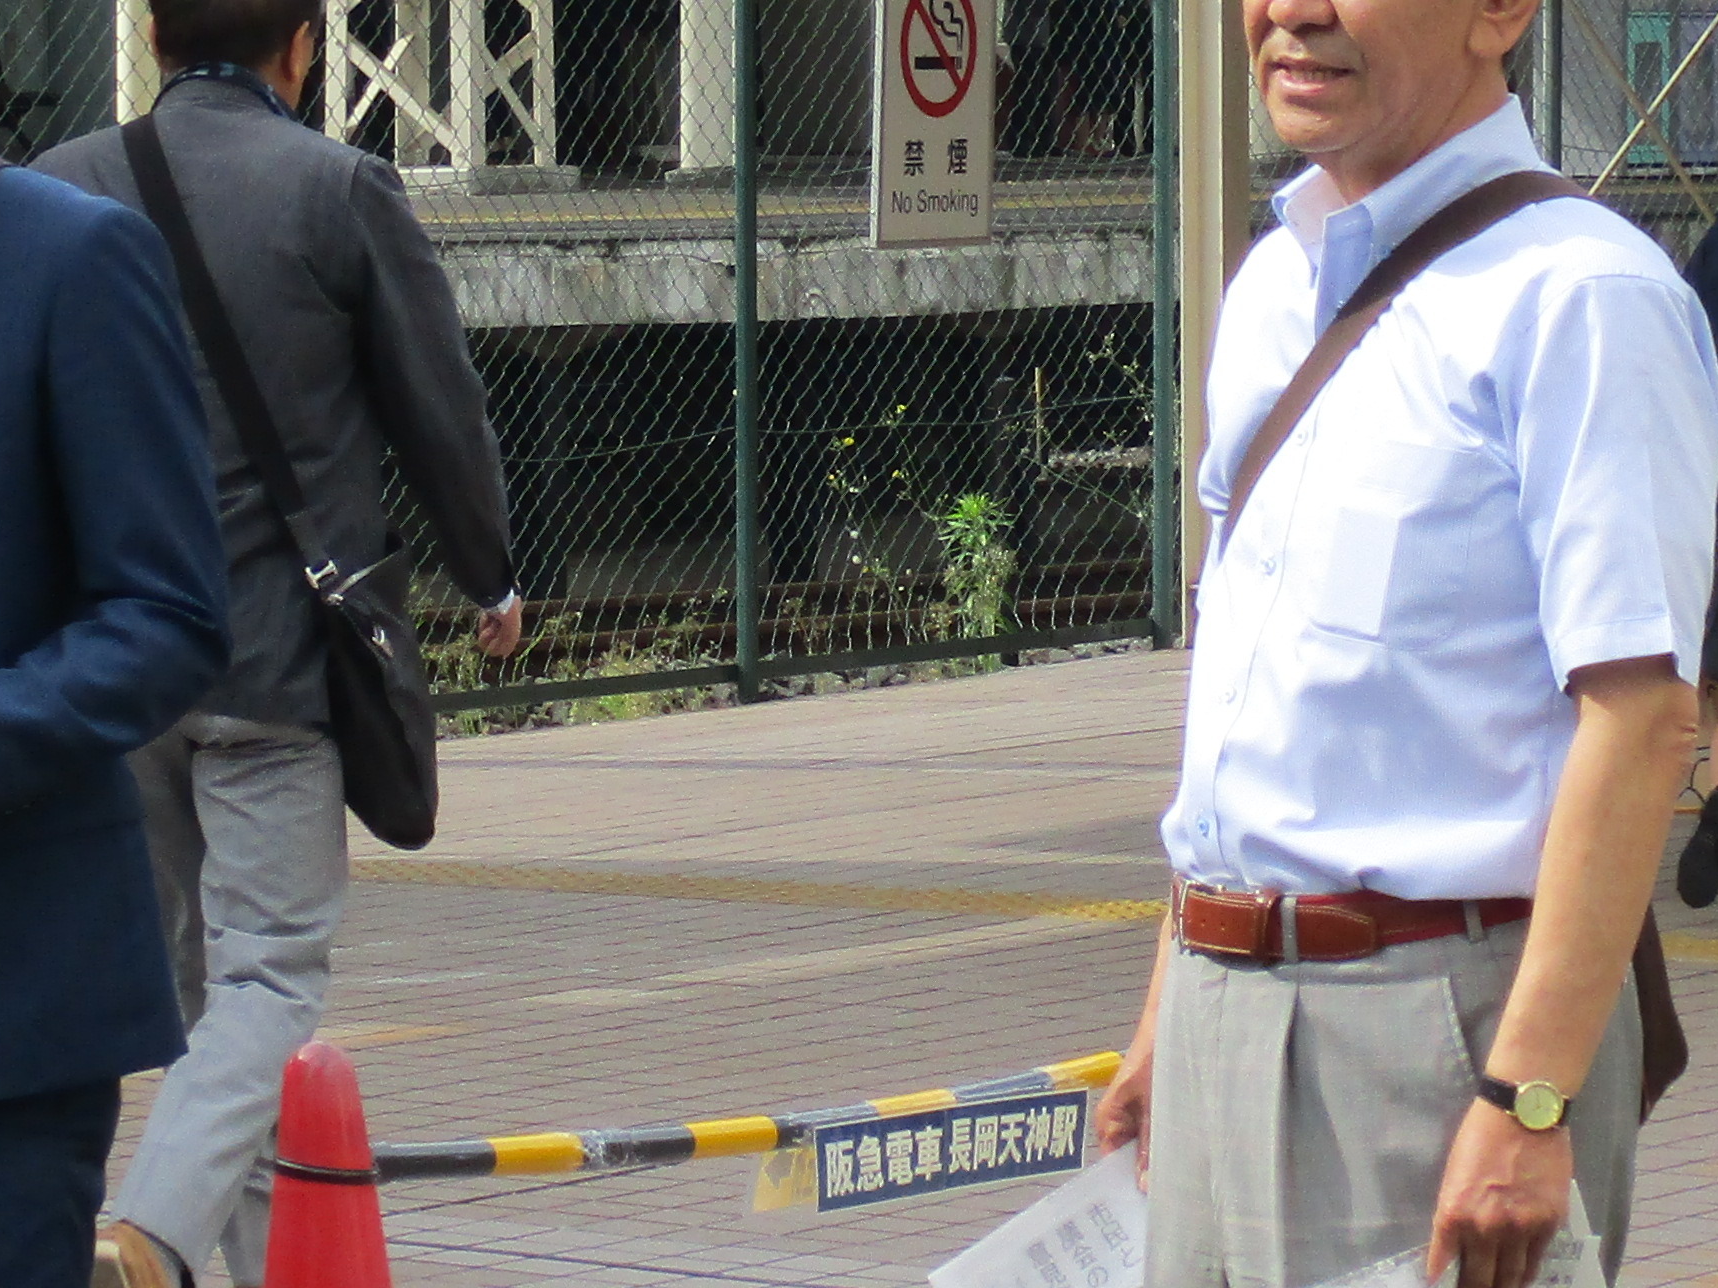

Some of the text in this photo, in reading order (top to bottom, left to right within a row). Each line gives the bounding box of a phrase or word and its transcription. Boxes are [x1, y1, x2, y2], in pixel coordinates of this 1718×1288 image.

[903, 138, 968, 177] 禁煙
[891, 189, 979, 216] No Smoking
[825, 1104, 1081, 1199] 阪急電車 長岡天神駅
